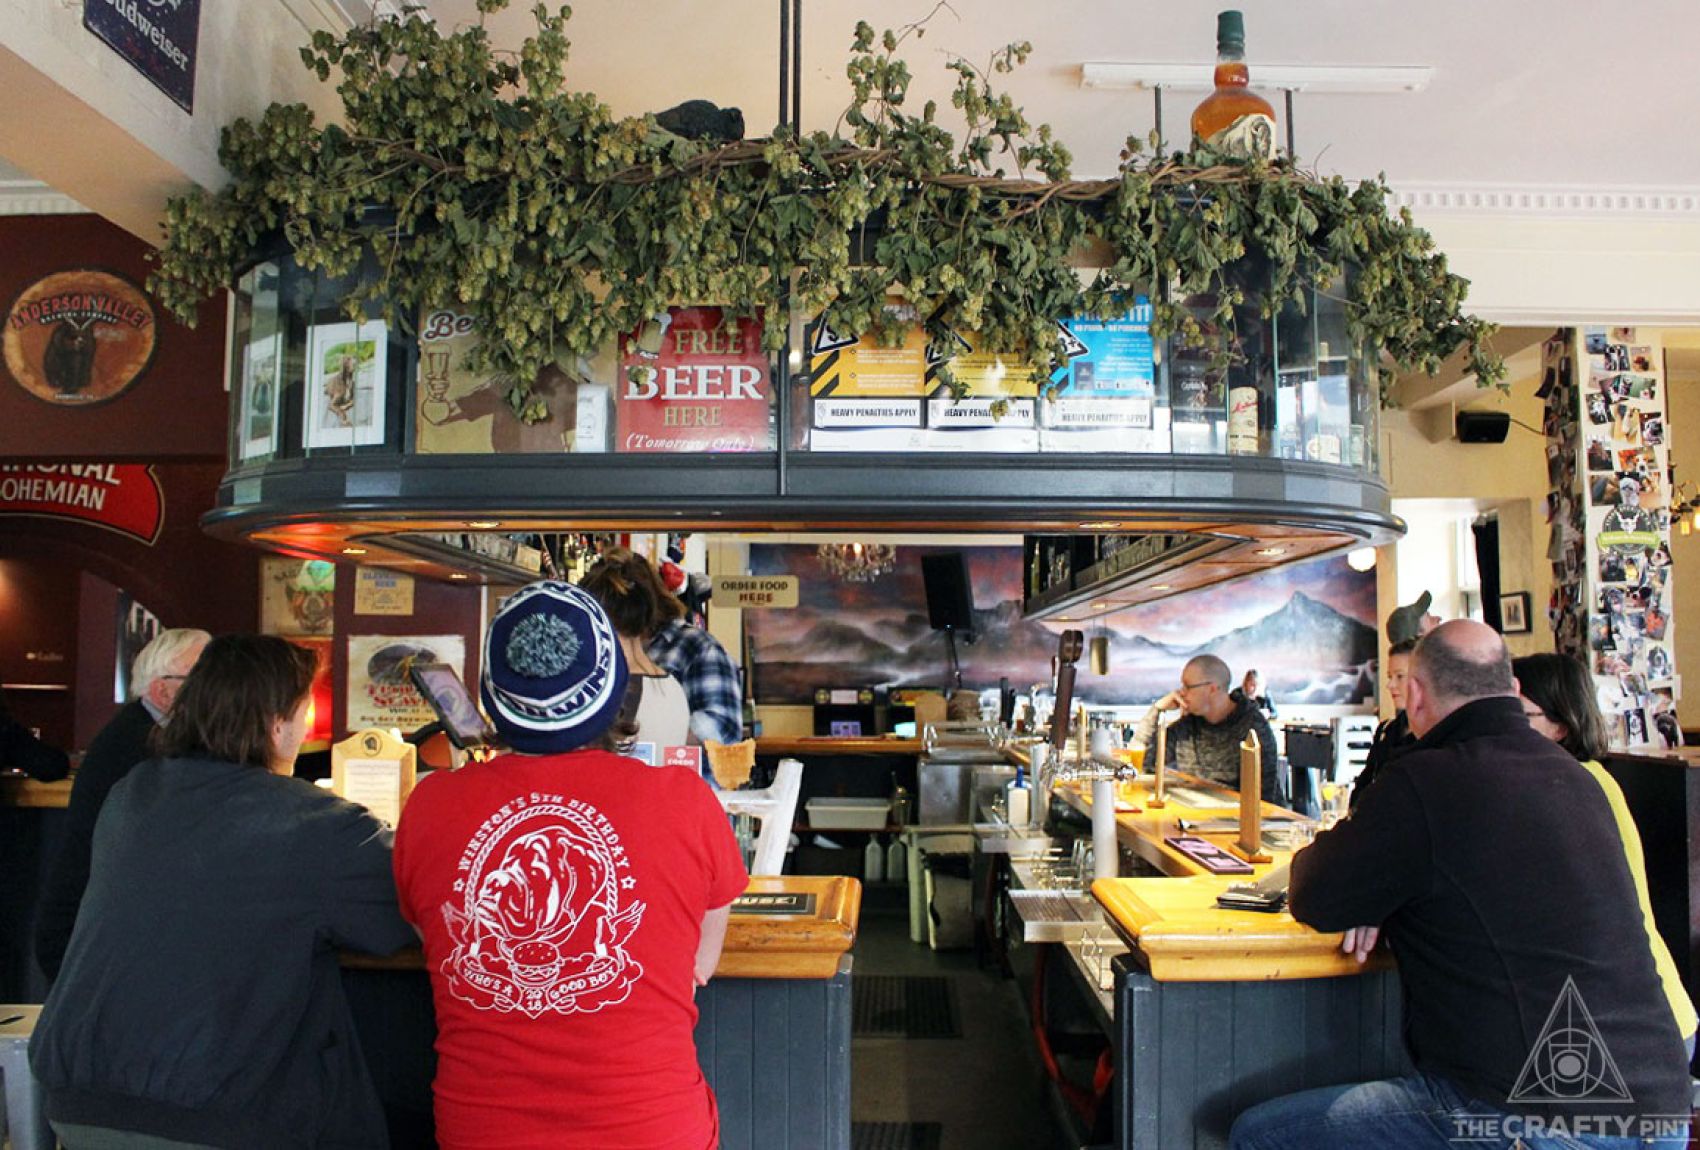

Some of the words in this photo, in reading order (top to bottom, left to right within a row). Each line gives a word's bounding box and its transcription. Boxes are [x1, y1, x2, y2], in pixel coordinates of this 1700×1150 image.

[105, 0, 187, 72] udweiser
[11, 294, 91, 329] ANDERSON
[97, 294, 150, 329] VALLEY
[423, 311, 474, 340] Be
[673, 328, 744, 354] FREE
[624, 365, 764, 401] BEER
[664, 406, 723, 427] HERE
[830, 408, 854, 417] HEAVY
[856, 408, 893, 417] PENALTIES
[895, 408, 917, 417] APPLY
[944, 408, 967, 417] HEAVY
[0, 478, 106, 511] OHEMIAN
[721, 581, 757, 591] ORDER
[759, 581, 788, 591] FOOD
[739, 593, 773, 602] HERE
[458, 796, 527, 871] WINSTON'S
[568, 799, 630, 868] BIRTHDAY
[502, 984, 514, 997] A
[550, 980, 587, 999] GOOD
[590, 966, 617, 987] BOY
